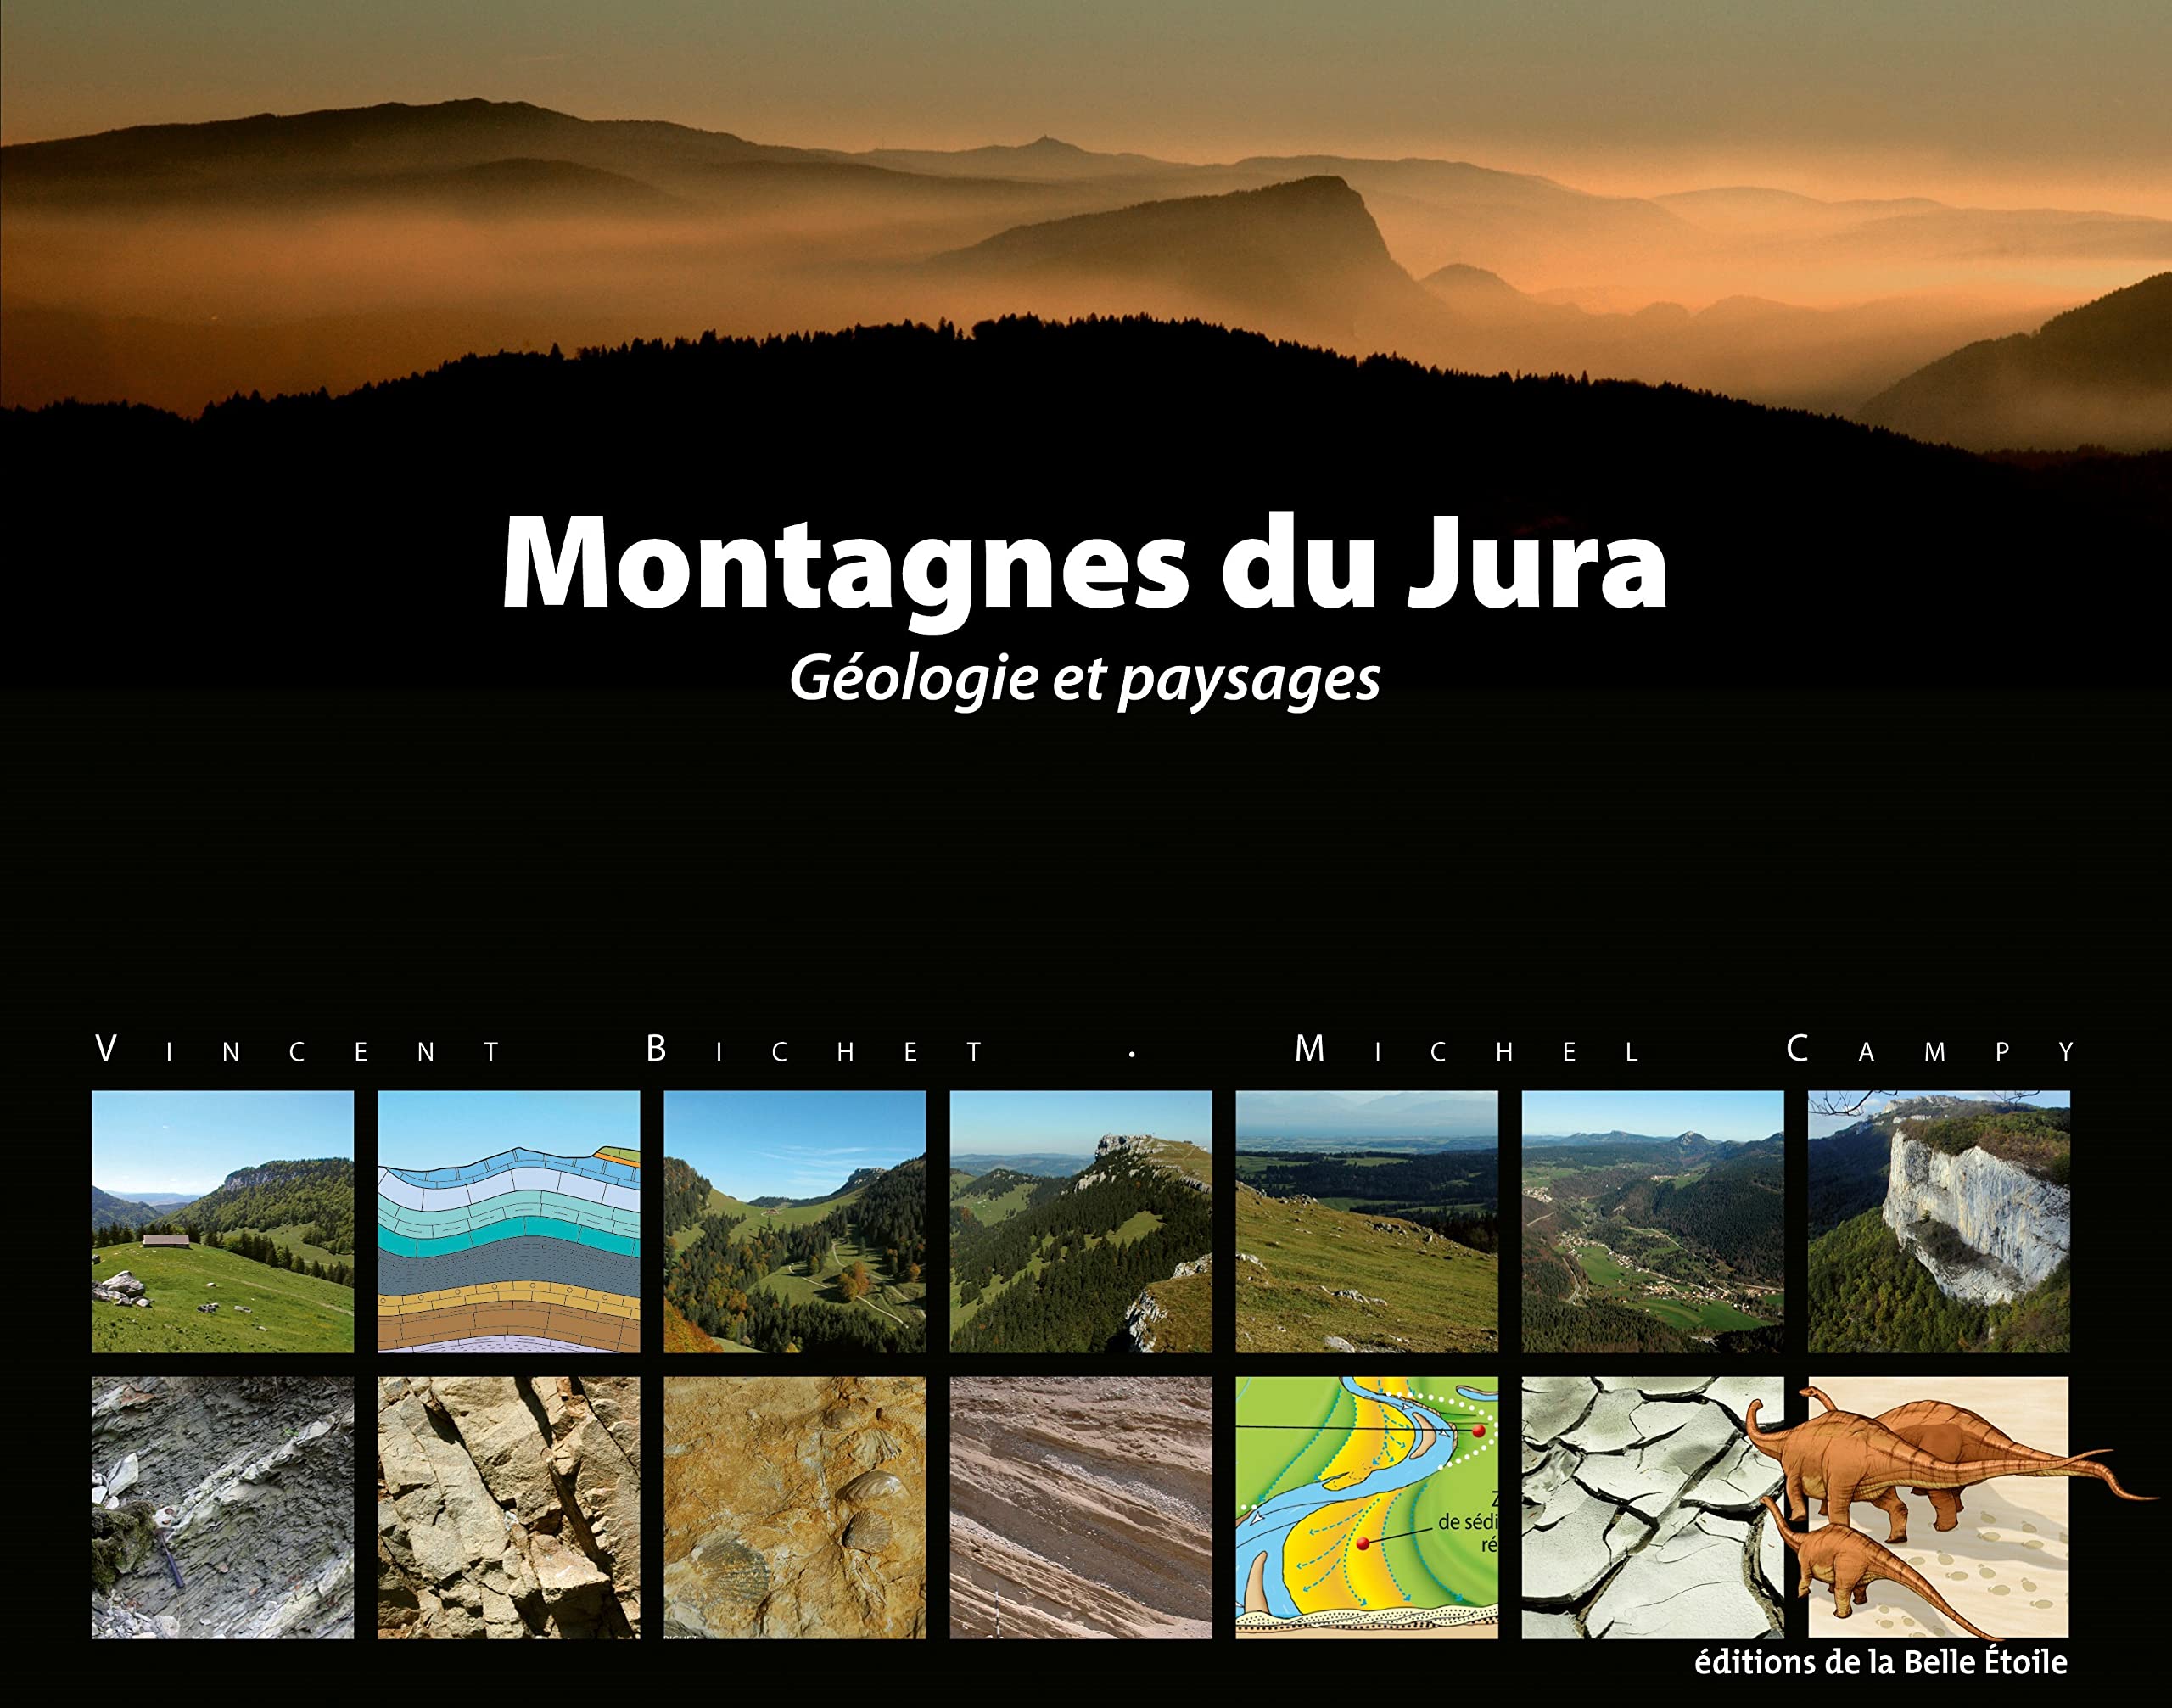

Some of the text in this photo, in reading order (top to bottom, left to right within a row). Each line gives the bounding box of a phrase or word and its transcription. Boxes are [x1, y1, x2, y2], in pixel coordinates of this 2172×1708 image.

[503, 510, 1666, 636] Montagnes du Jura
[791, 651, 1381, 715] Géologie et paysages
[1438, 1512, 1498, 1530] de sédi
[1481, 1535, 1497, 1553] ré
[1694, 1642, 2068, 1675] éditions de la Belle Étoile
